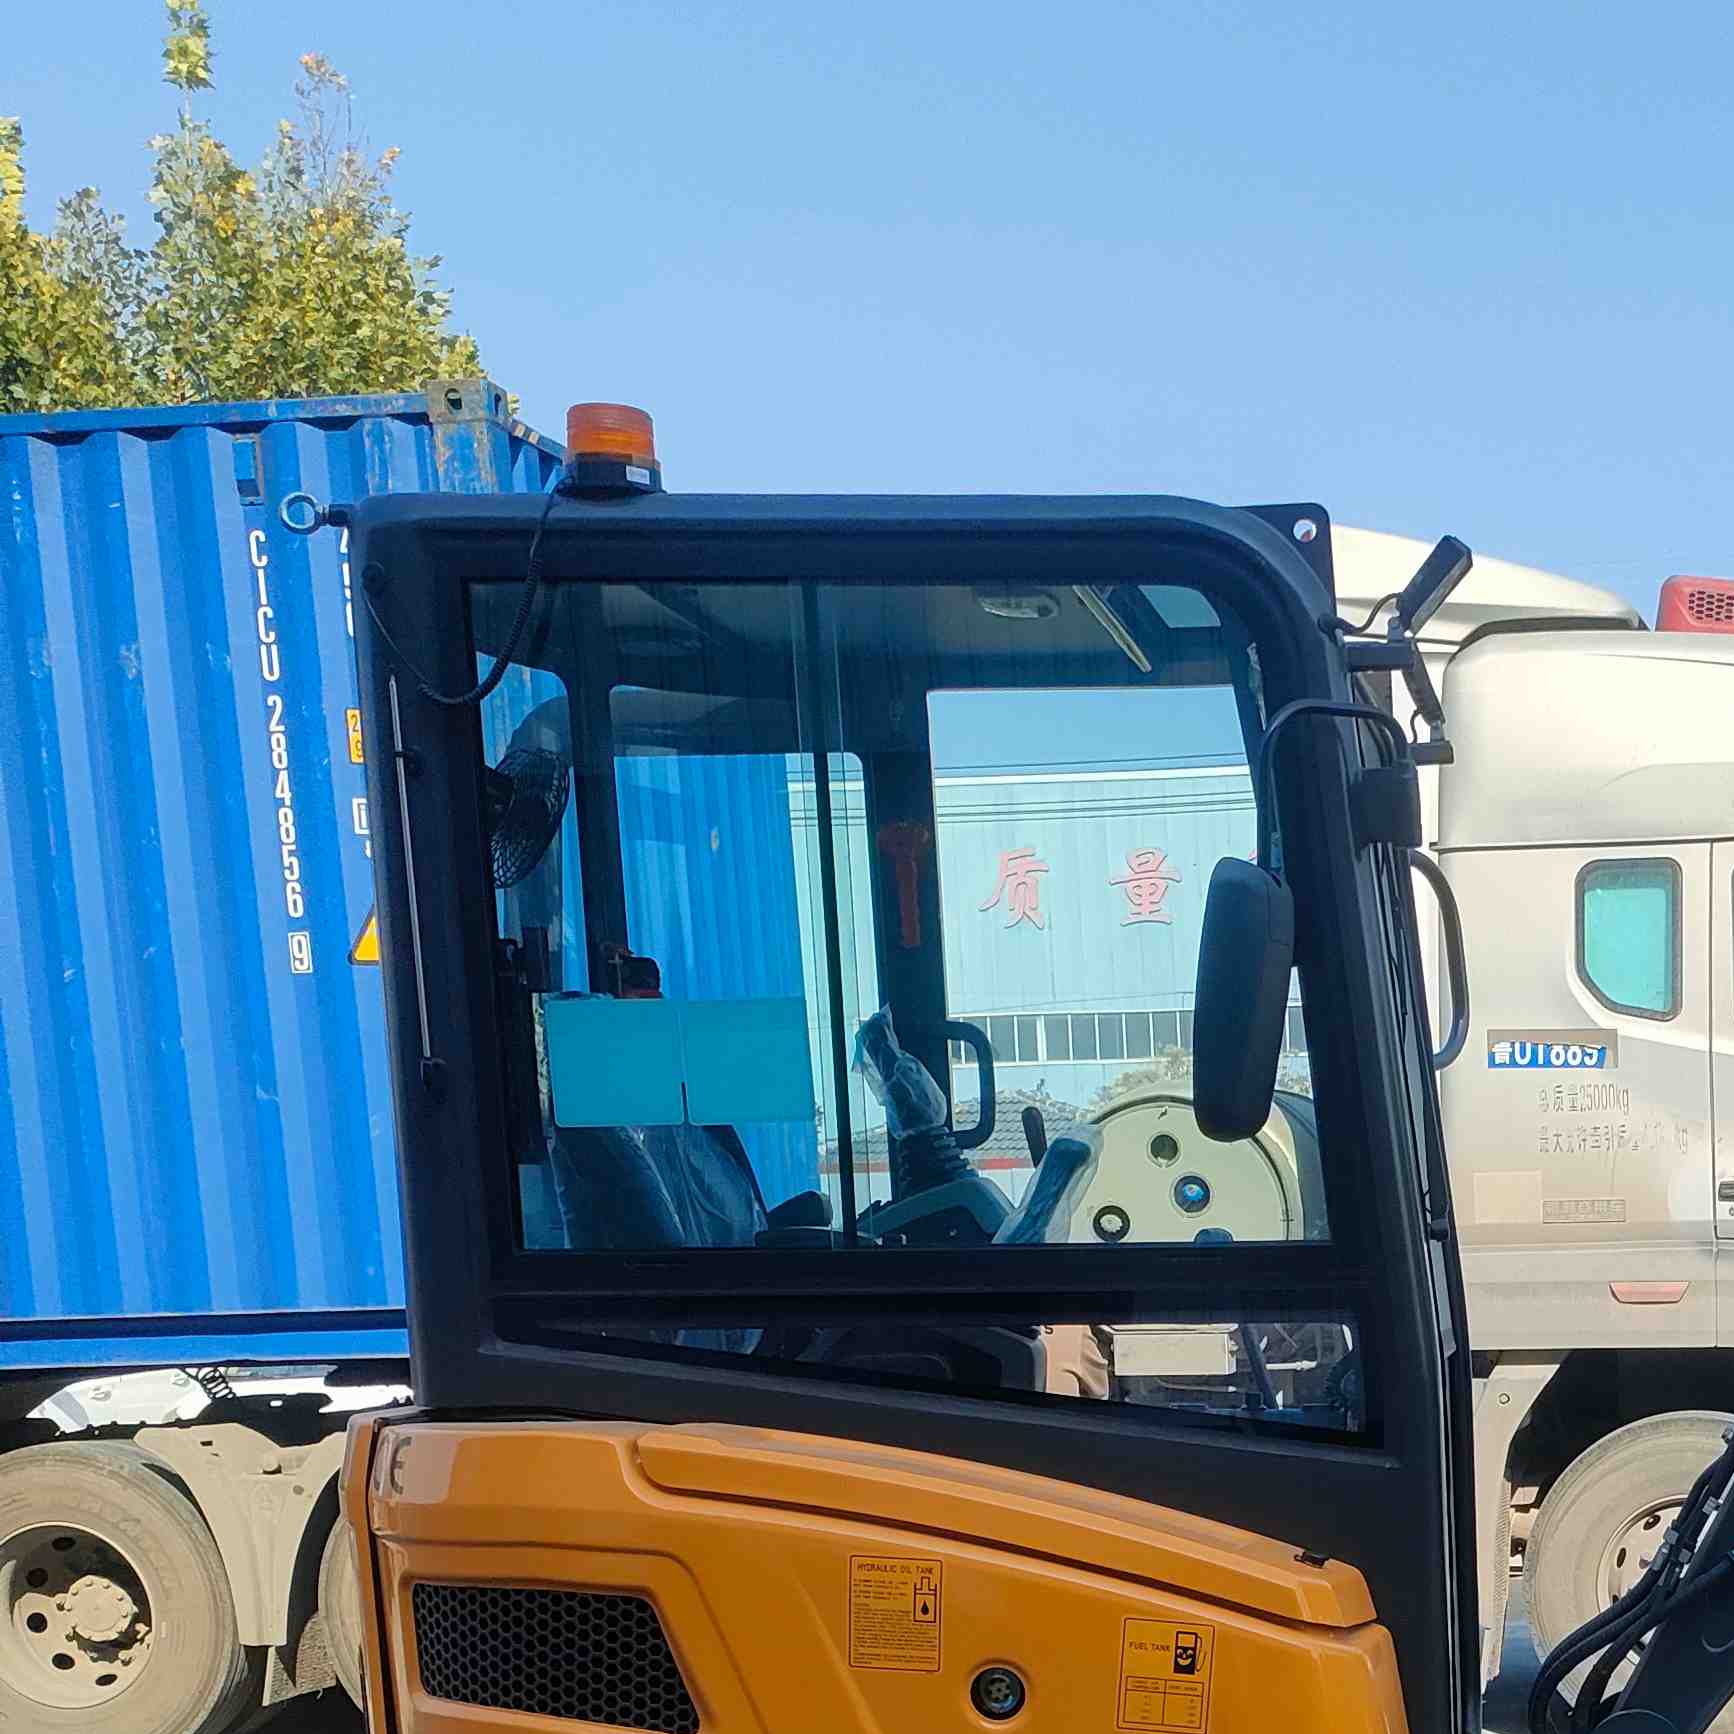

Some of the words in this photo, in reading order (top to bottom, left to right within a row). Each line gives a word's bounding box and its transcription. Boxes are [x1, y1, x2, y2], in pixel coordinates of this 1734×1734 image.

[249, 530, 280, 681] CICU
[266, 694, 304, 919] 284856
[290, 934, 310, 972] 9
[1129, 1641, 1148, 1651] FUEL
[1151, 1643, 1170, 1653] TANK
